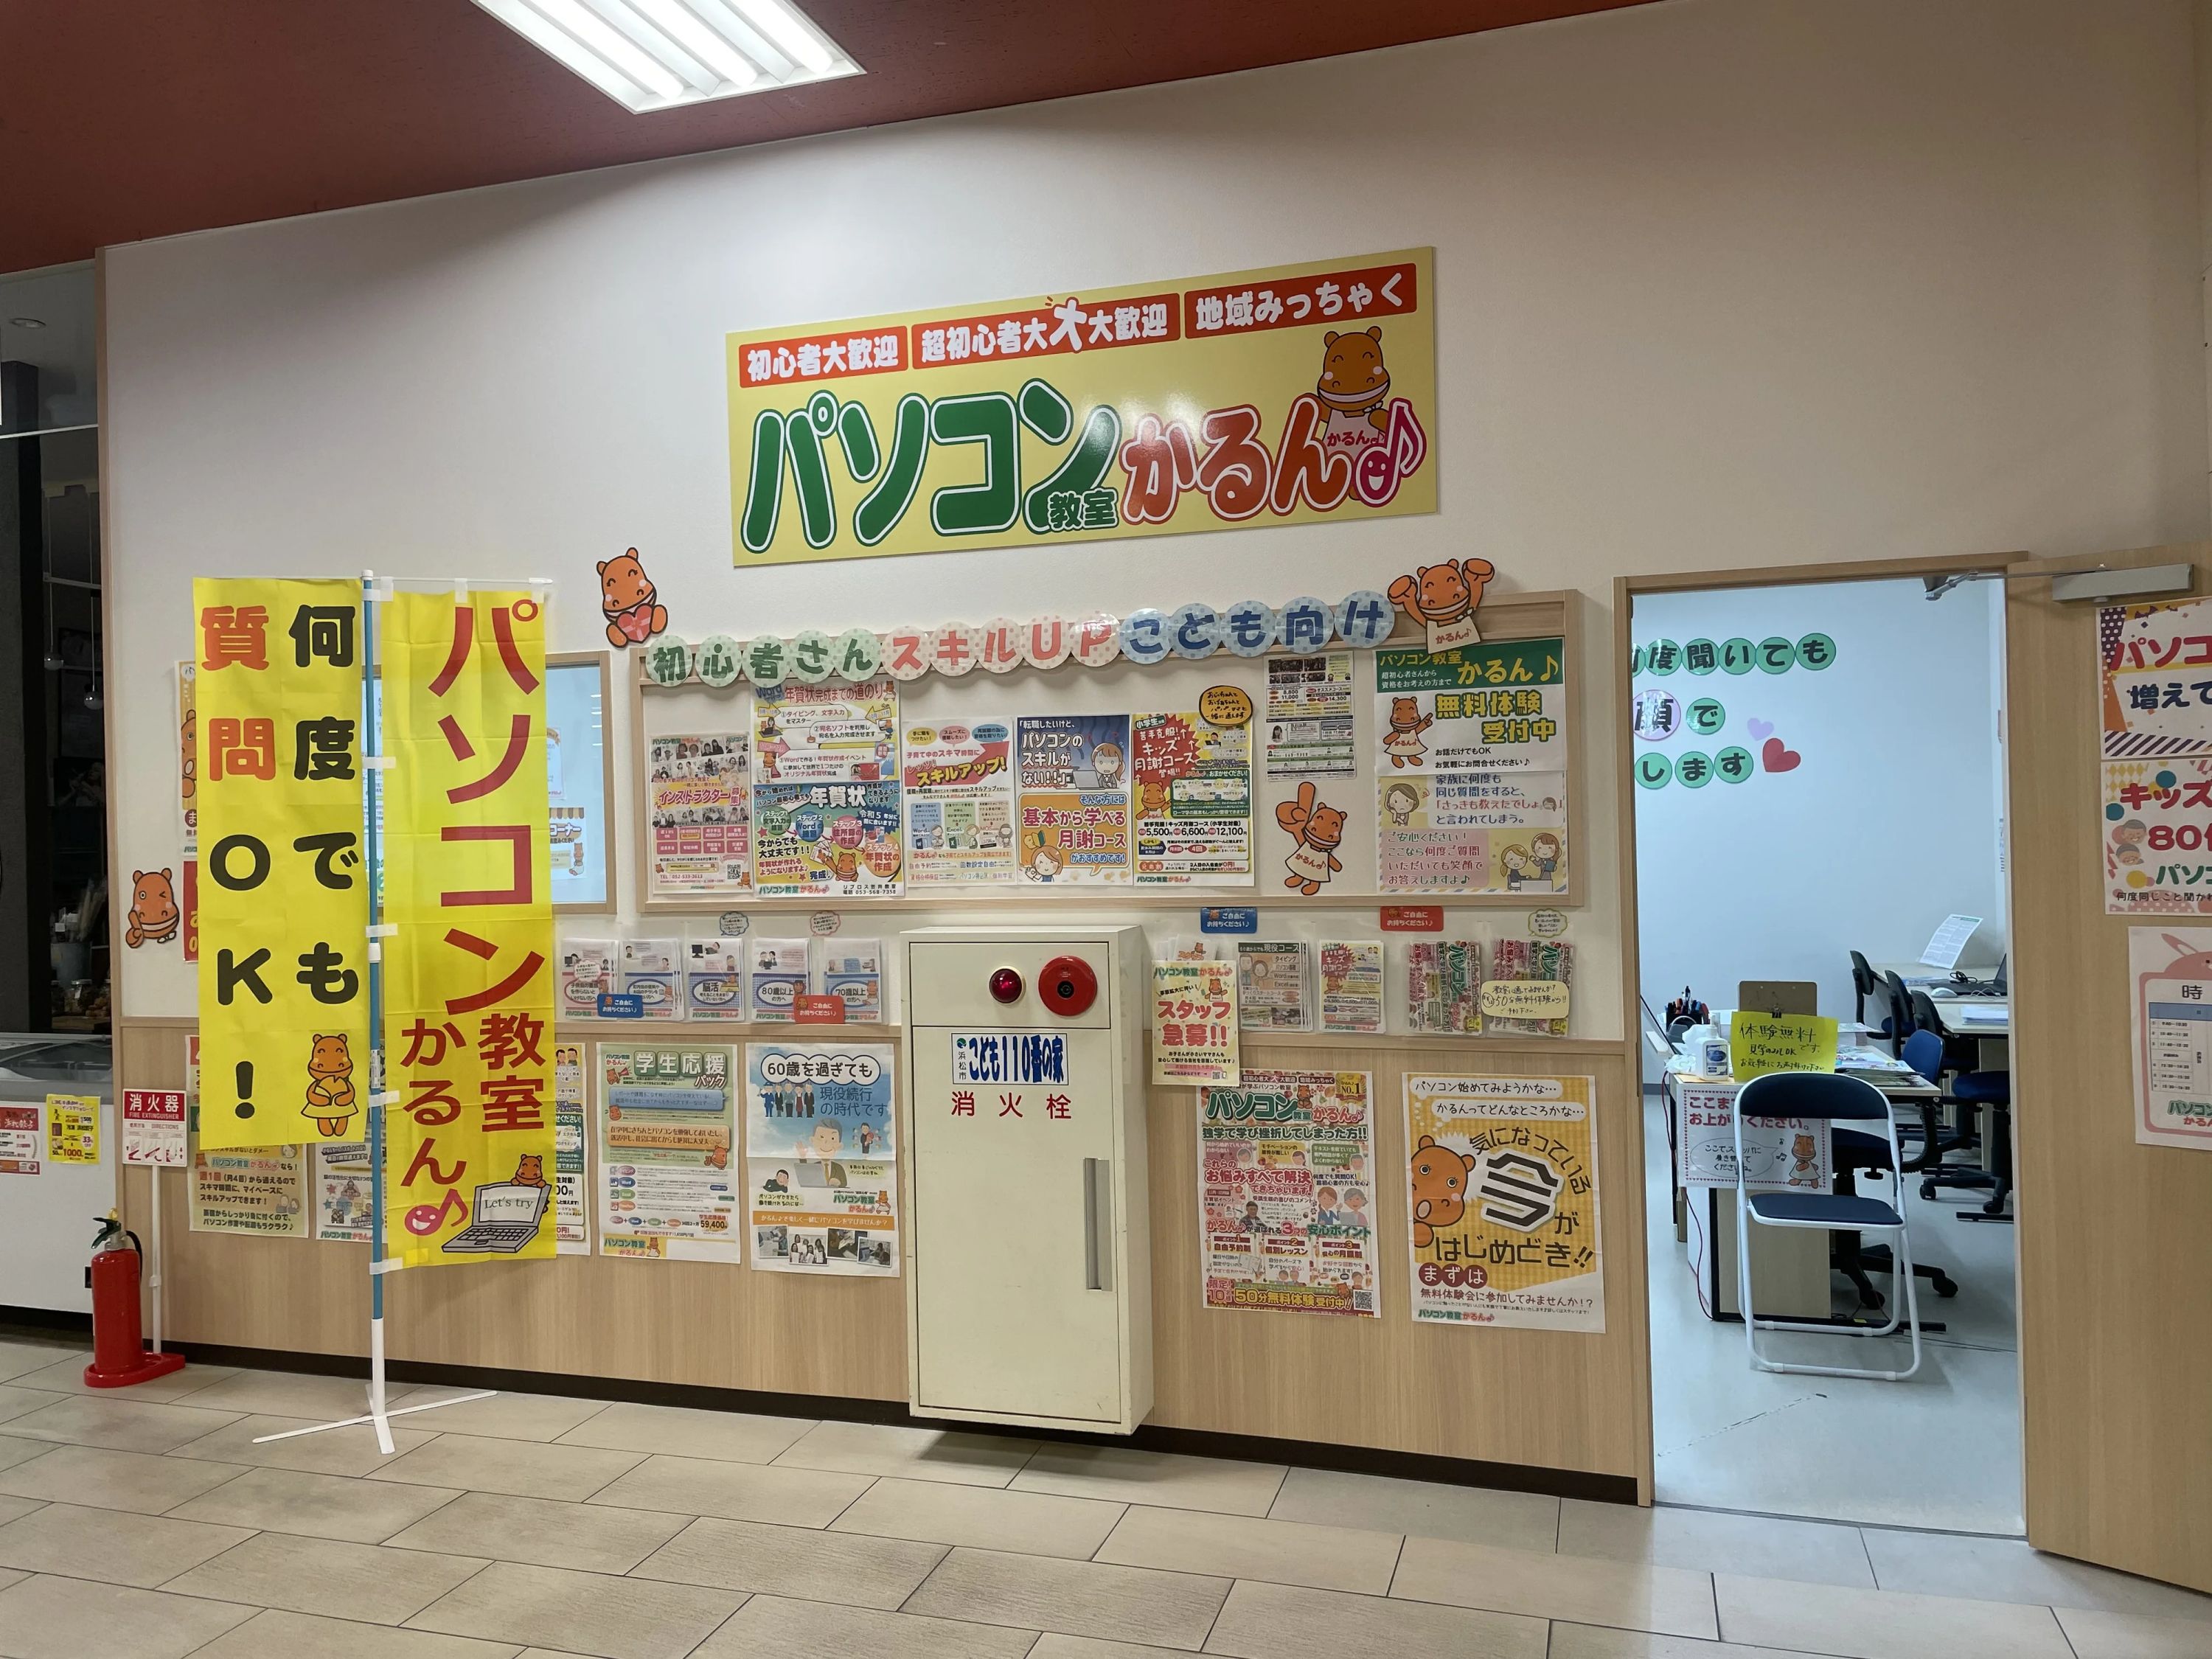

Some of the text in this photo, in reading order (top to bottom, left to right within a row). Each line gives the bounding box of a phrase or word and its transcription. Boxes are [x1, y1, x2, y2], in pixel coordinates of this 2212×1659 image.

[1197, 272, 1402, 331] 地域みっちゃく
[920, 297, 1167, 363] 超初心者大大大歓迎
[748, 333, 900, 381] 初心者大歓迎
[1327, 431, 1371, 447] かるん
[740, 377, 1122, 554] パソコン
[1121, 391, 1354, 526] かるん
[1048, 488, 1119, 529] 教室
[653, 601, 1384, 684] 初心者さん スキルUP こども向け
[1436, 630, 1464, 644] かるん
[1380, 650, 1463, 667] パソコン教室
[1381, 669, 1437, 679] 超初心者さんから
[1457, 658, 1534, 686] かるん
[1381, 679, 1452, 689] 資格をお考えの方まで
[785, 683, 884, 703] 年賀状完成までの道のり
[1435, 689, 1543, 719] 無料体験
[1020, 720, 1075, 728] 「転職したいけど、
[1482, 718, 1556, 745] 受付中
[1022, 731, 1083, 748] パソコンの
[1140, 727, 1179, 741] 苦手克服!
[1143, 737, 1180, 756] キッズ
[1435, 747, 1491, 757] お話だけでもOK
[1022, 751, 1071, 767] スキルが
[1135, 753, 1195, 771] 月謝コース
[1642, 752, 1746, 782] します
[917, 757, 1008, 787] スキルアップ!
[1436, 774, 1501, 785] 家族に何度も
[658, 788, 731, 805] インストラクター
[810, 785, 867, 808] 年賀状
[1079, 794, 1126, 805] そんな方には
[1436, 787, 1525, 798] 同じ質問をすると、
[288, 604, 359, 1007] 何度でも
[429, 598, 546, 1016] パソコン
[796, 814, 823, 822] ステップ2
[860, 810, 882, 819] 令和5
[1023, 807, 1125, 827] 基本から学べる
[1436, 814, 1524, 824] と言われてしまう。
[758, 836, 798, 848] 今からでも
[840, 837, 855, 845] 作成
[1058, 830, 1127, 849] 月謝コース
[1388, 832, 1467, 843] ご安心ください!
[759, 846, 810, 858] 大丈夫です!!
[865, 852, 900, 861] 年賀状の
[1071, 853, 1126, 864] がおすすめです!
[1388, 846, 1480, 857] ここなら何度ご質問
[200, 605, 276, 1120] 質問OK!
[874, 863, 892, 871] 作成
[1388, 860, 1484, 871] いただいても笑顔で
[1264, 944, 1301, 952] 現役コース
[1154, 967, 1198, 977] パソコン教室
[703, 982, 719, 992] 脳活
[762, 987, 793, 995] 80歳以上
[835, 987, 866, 996] 70歳以上
[2182, 985, 2203, 1000] 時
[1158, 1000, 1231, 1020] スタッフ
[1162, 1023, 1228, 1047] 急募!!
[1739, 1022, 1817, 1043] 体験無料
[636, 1053, 726, 1075] 学生応援
[959, 1051, 967, 1080] 浜松市
[969, 1034, 1064, 1083] こども110番の家
[479, 1012, 546, 1132] 教室
[768, 1061, 873, 1078] 60歳を過ぎても
[694, 1076, 726, 1088] パック
[1416, 1081, 1557, 1094] パソコン始めてみようかな…
[130, 1093, 179, 1113] 消火器
[400, 1017, 466, 1188] かるん
[820, 1087, 873, 1102] 現役続行
[820, 1102, 887, 1117] の時代です
[951, 1091, 1072, 1119] 消火栓
[1206, 1091, 1298, 1121] パソコン
[1436, 1102, 1585, 1117] かるんってどんなところかな…
[1312, 1106, 1352, 1123] かるん
[1203, 1126, 1368, 1141] 独学で学び挫折してしまった方!!
[1203, 1158, 1237, 1169] これらの
[1470, 1127, 1593, 1194] 気になっている
[1205, 1169, 1313, 1185] お悩みすべて解決
[1251, 1183, 1314, 1197] できちゃいます!
[200, 1194, 267, 1205] スキルアップできます!
[484, 1194, 534, 1211] Let's try
[1554, 1211, 1579, 1235] が
[1436, 1234, 1594, 1269] はじめどき!!
[1423, 1264, 1484, 1284] まずは
[1420, 1288, 1593, 1308] 無料体験会に参加してみませんか!?
